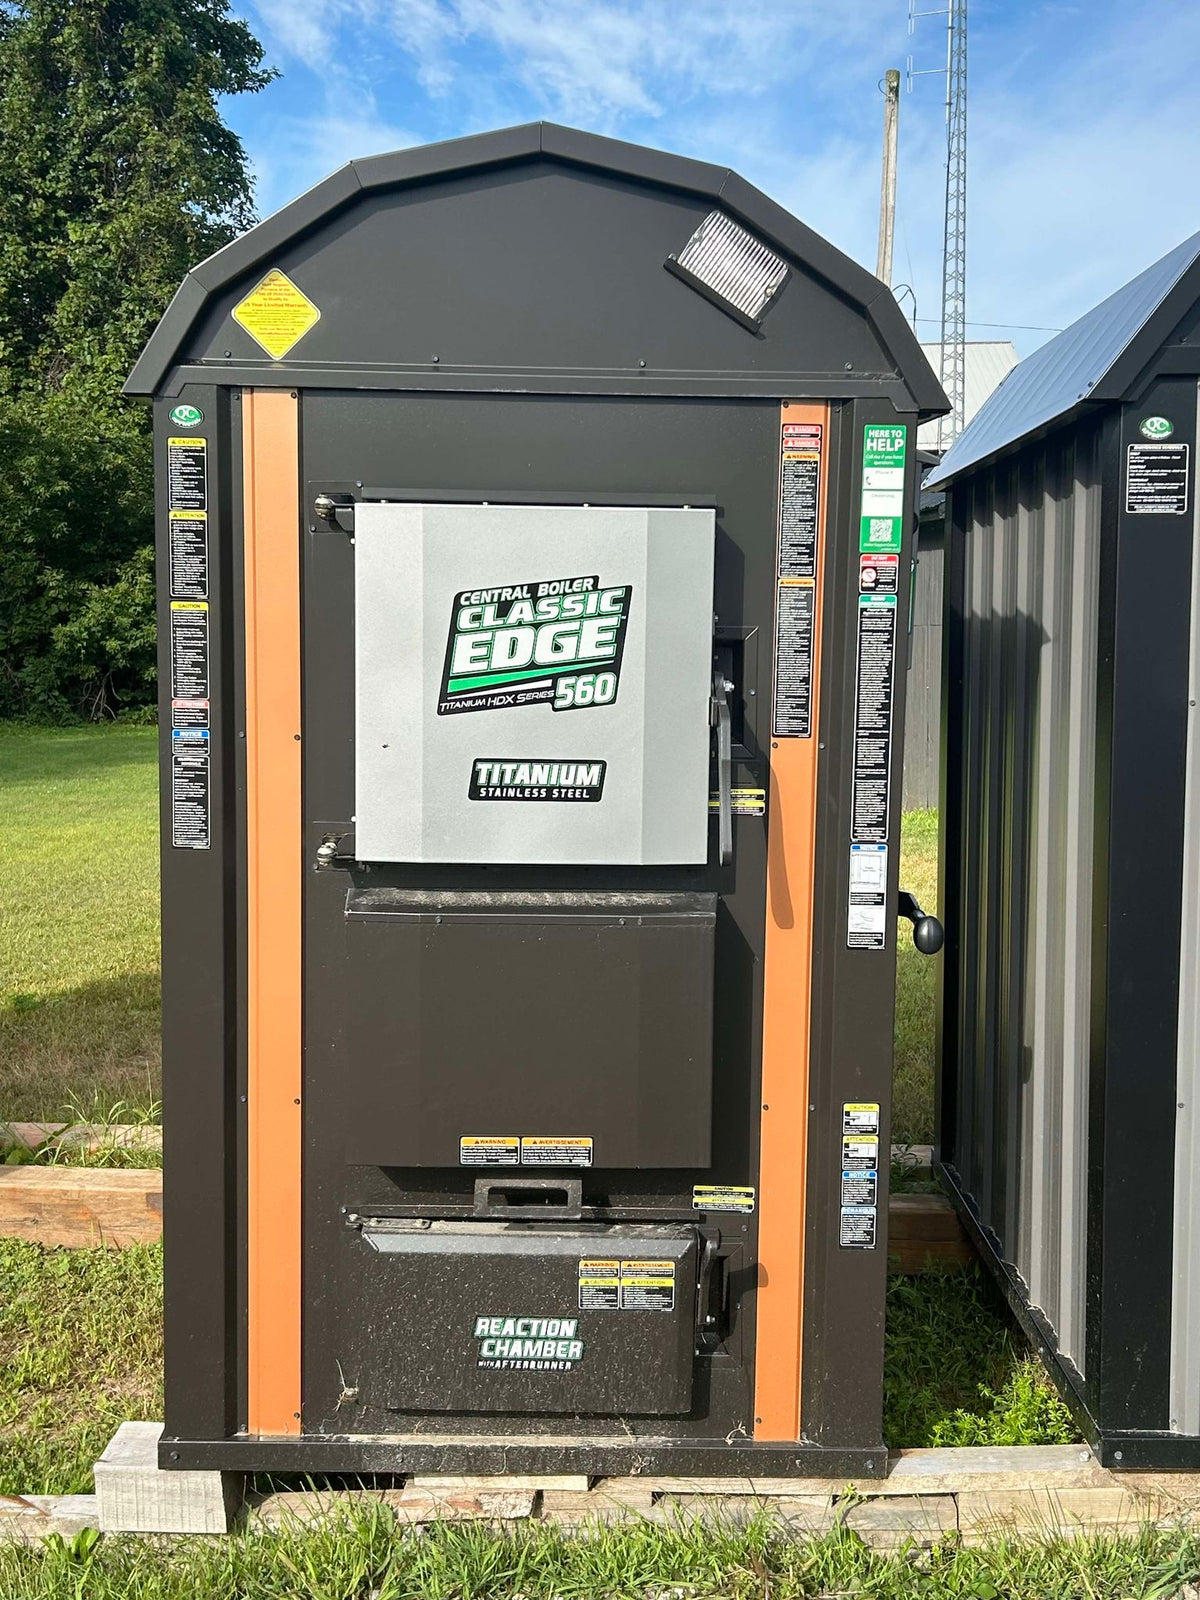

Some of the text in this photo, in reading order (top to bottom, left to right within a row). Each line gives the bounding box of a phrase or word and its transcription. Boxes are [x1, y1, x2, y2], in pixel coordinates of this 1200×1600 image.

[178, 408, 197, 420] QC
[1146, 420, 1168, 432] QC
[867, 438, 904, 451] HELP
[460, 578, 594, 606] CENTRAL BOILER
[457, 588, 625, 631] CLASSIC
[450, 614, 621, 675] EDGE
[554, 672, 617, 708] 560
[440, 699, 486, 712] TITANIUM
[487, 694, 515, 707] HDX
[475, 762, 602, 787] TITANIUM
[480, 788, 590, 798] STAINLESS STEEL
[474, 1316, 578, 1338] REACTION
[480, 1338, 584, 1359] CHAMBER
[494, 1360, 572, 1370] AFTERBURNER
